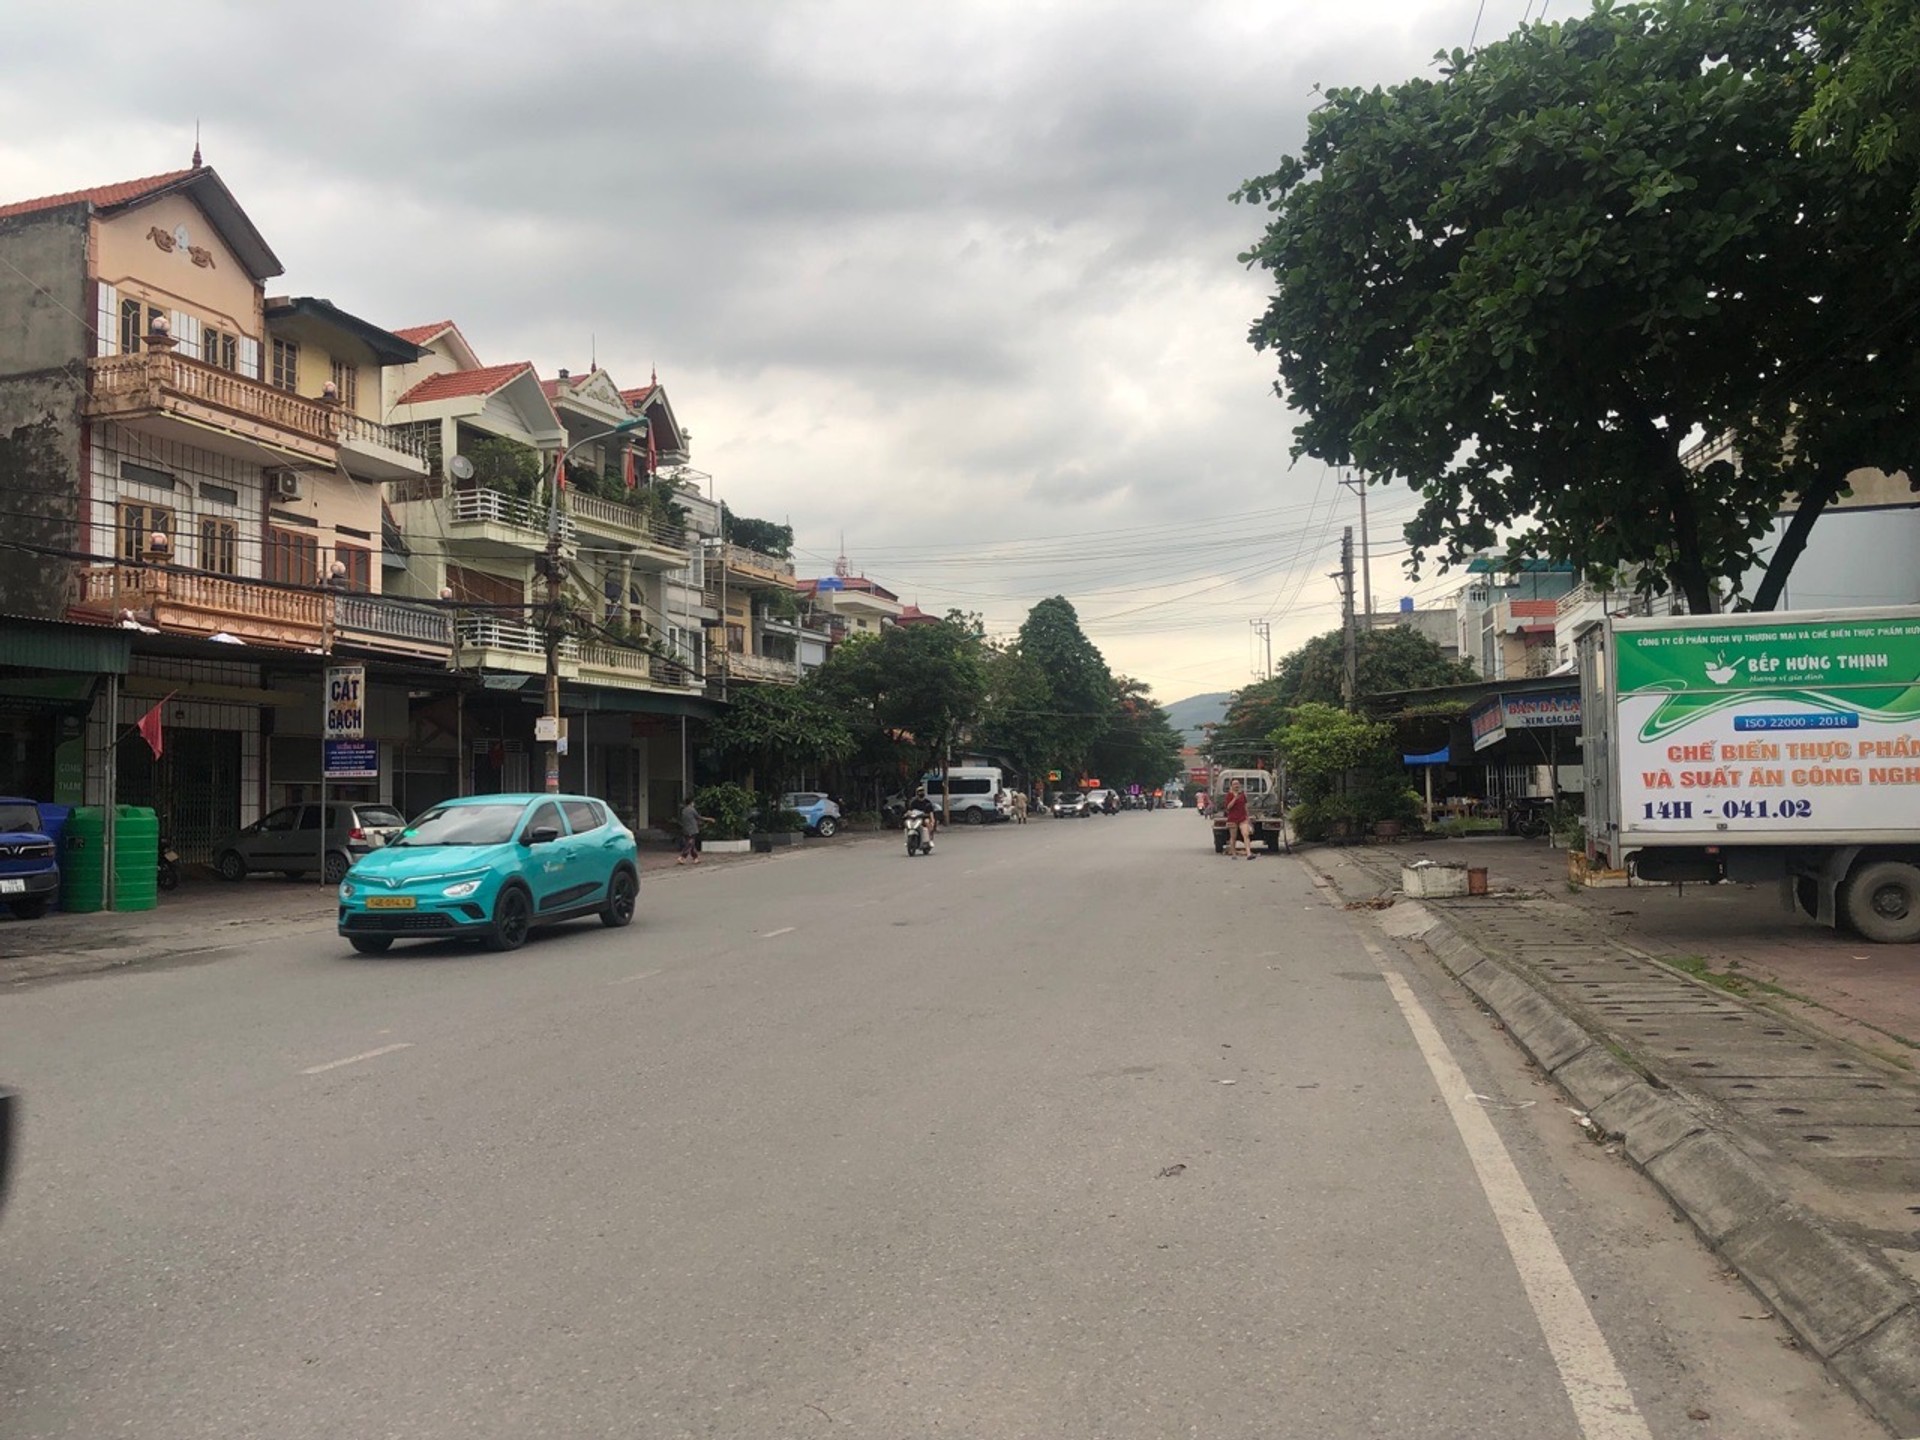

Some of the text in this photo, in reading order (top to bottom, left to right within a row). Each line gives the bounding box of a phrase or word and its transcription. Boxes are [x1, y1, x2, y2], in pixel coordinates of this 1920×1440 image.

[1637, 637, 1660, 647] CÔNG
[1661, 637, 1671, 645] TY
[1710, 634, 1729, 645] DỊCH
[1731, 634, 1743, 643] VỤ
[1779, 631, 1797, 641] MẠI
[1748, 652, 1889, 673] BẾP HƯNG THỊNH
[1508, 700, 1537, 715] BÁN
[328, 709, 362, 732] GẠCH
[1745, 719, 1767, 729] ISO
[1770, 717, 1806, 728] 22000
[1819, 716, 1848, 727] 2018
[1667, 740, 1718, 763] CHẾ
[1721, 739, 1780, 761] BIẾN
[1786, 741, 1852, 763] THỰC
[1642, 767, 1675, 789] VÀ
[1680, 765, 1742, 788] SUẤT
[1748, 766, 1785, 788] ĂN
[1791, 765, 1862, 787] CÔNG
[1642, 801, 1693, 820] 14H
[1722, 799, 1813, 819] 041.02
